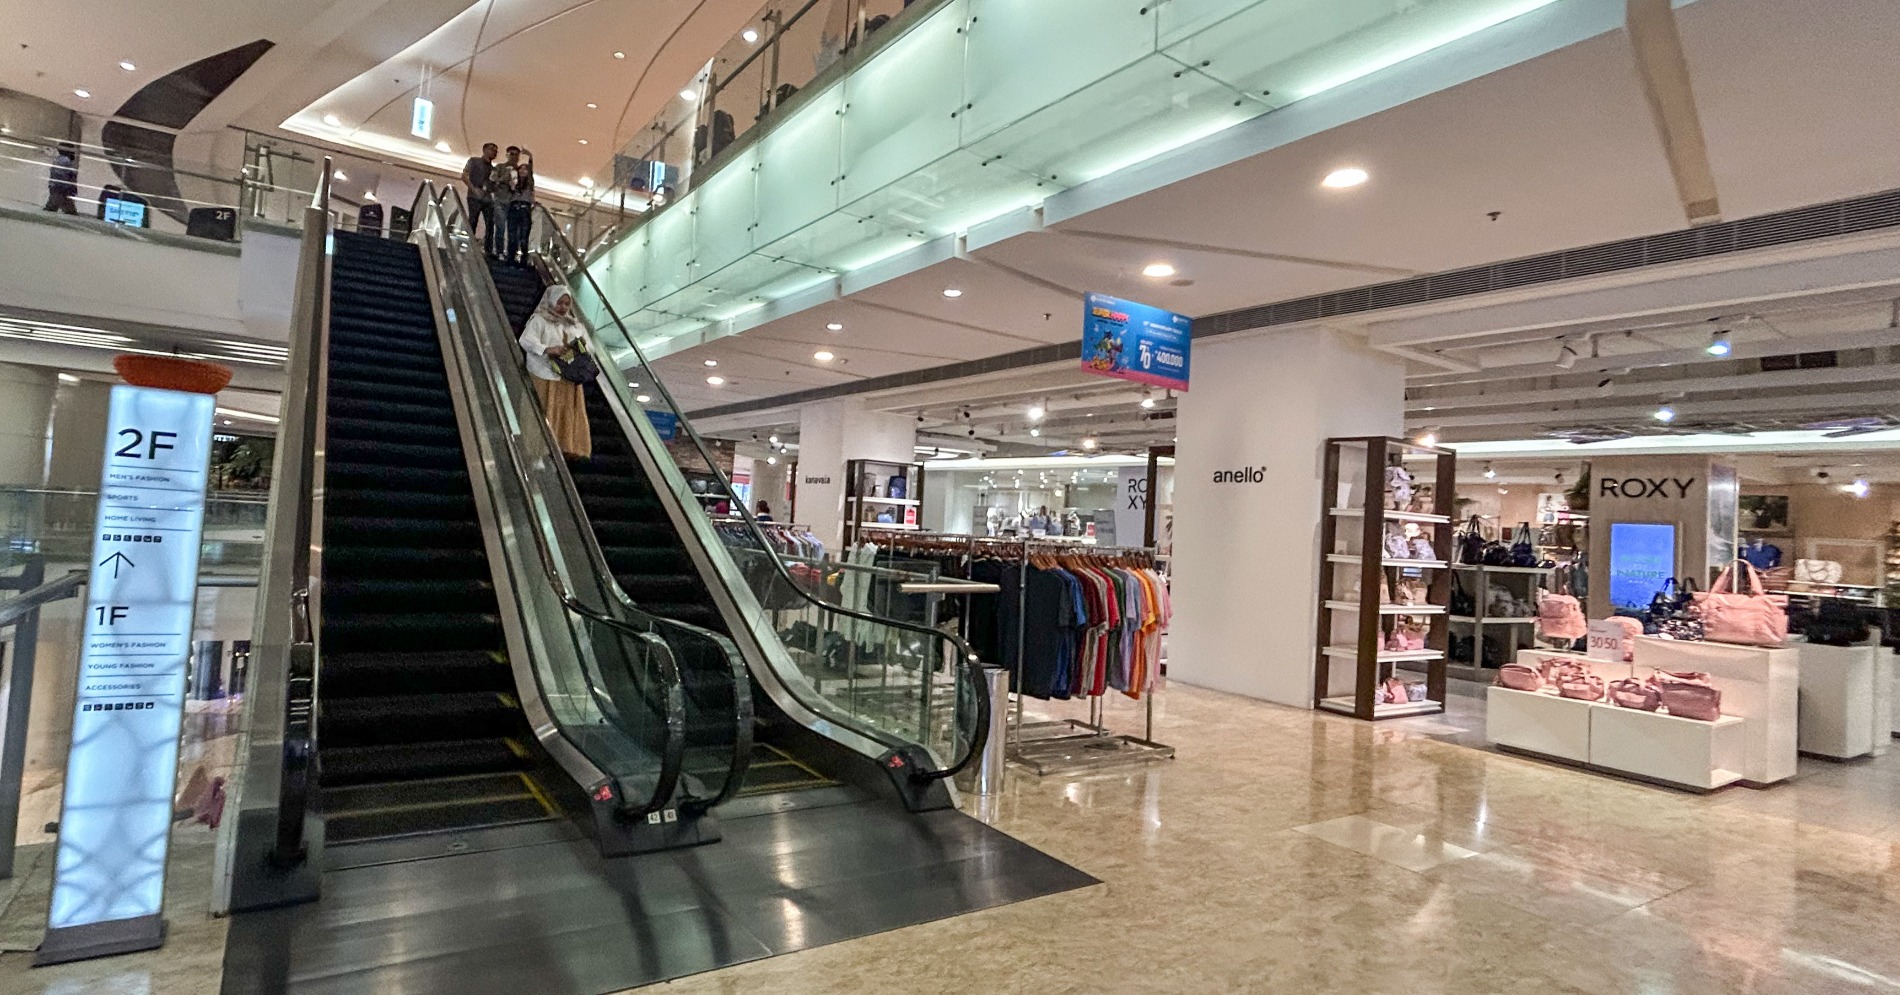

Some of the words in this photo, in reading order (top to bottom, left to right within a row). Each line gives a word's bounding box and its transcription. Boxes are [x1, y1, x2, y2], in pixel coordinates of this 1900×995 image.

[215, 210, 231, 221] 2F
[115, 428, 177, 460] 2F
[1213, 467, 1264, 483] anello
[1600, 478, 1695, 499] ROXY
[95, 606, 129, 626] 1F
